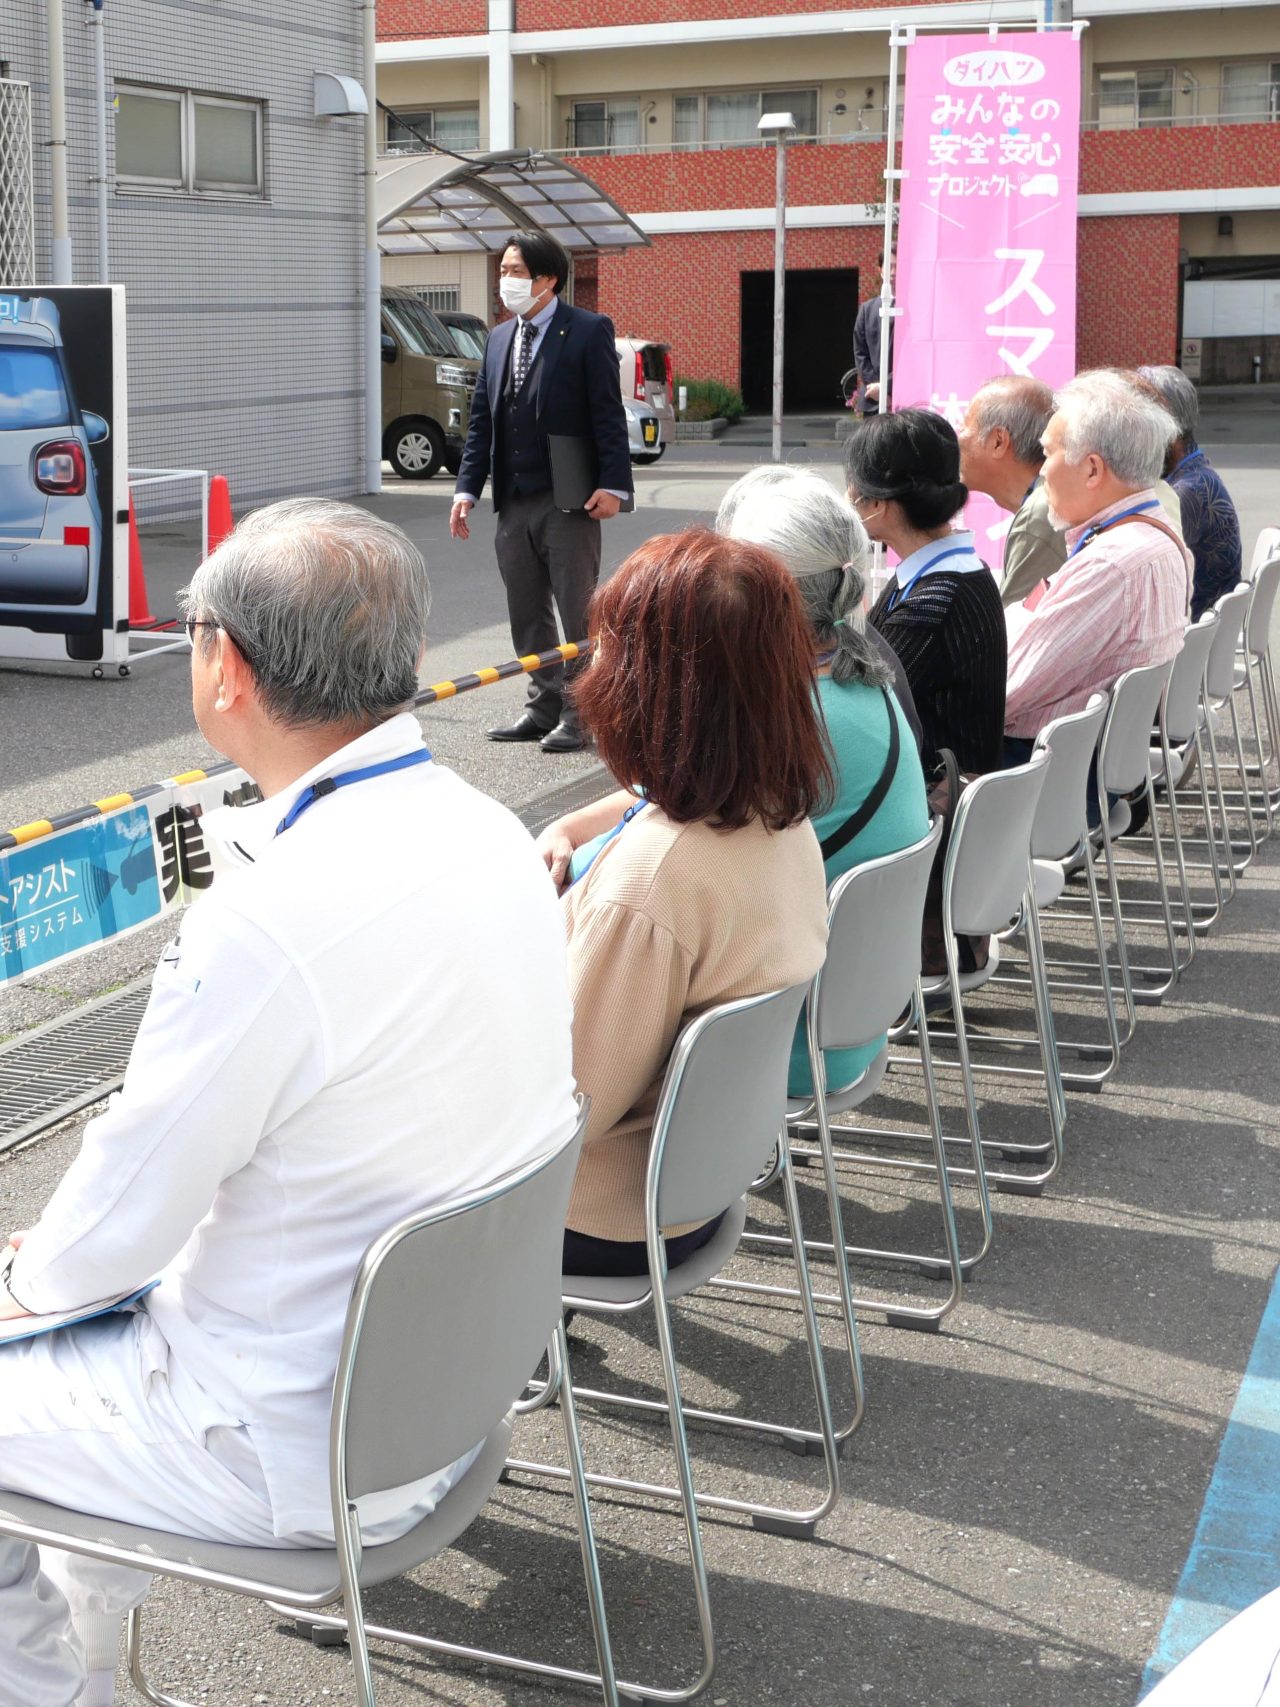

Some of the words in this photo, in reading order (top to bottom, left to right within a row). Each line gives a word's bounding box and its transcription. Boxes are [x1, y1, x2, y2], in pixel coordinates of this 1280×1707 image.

[953, 60, 1035, 82] ダイハツ
[930, 91, 1061, 127] みんなの
[927, 172, 1018, 198] プロジェクト
